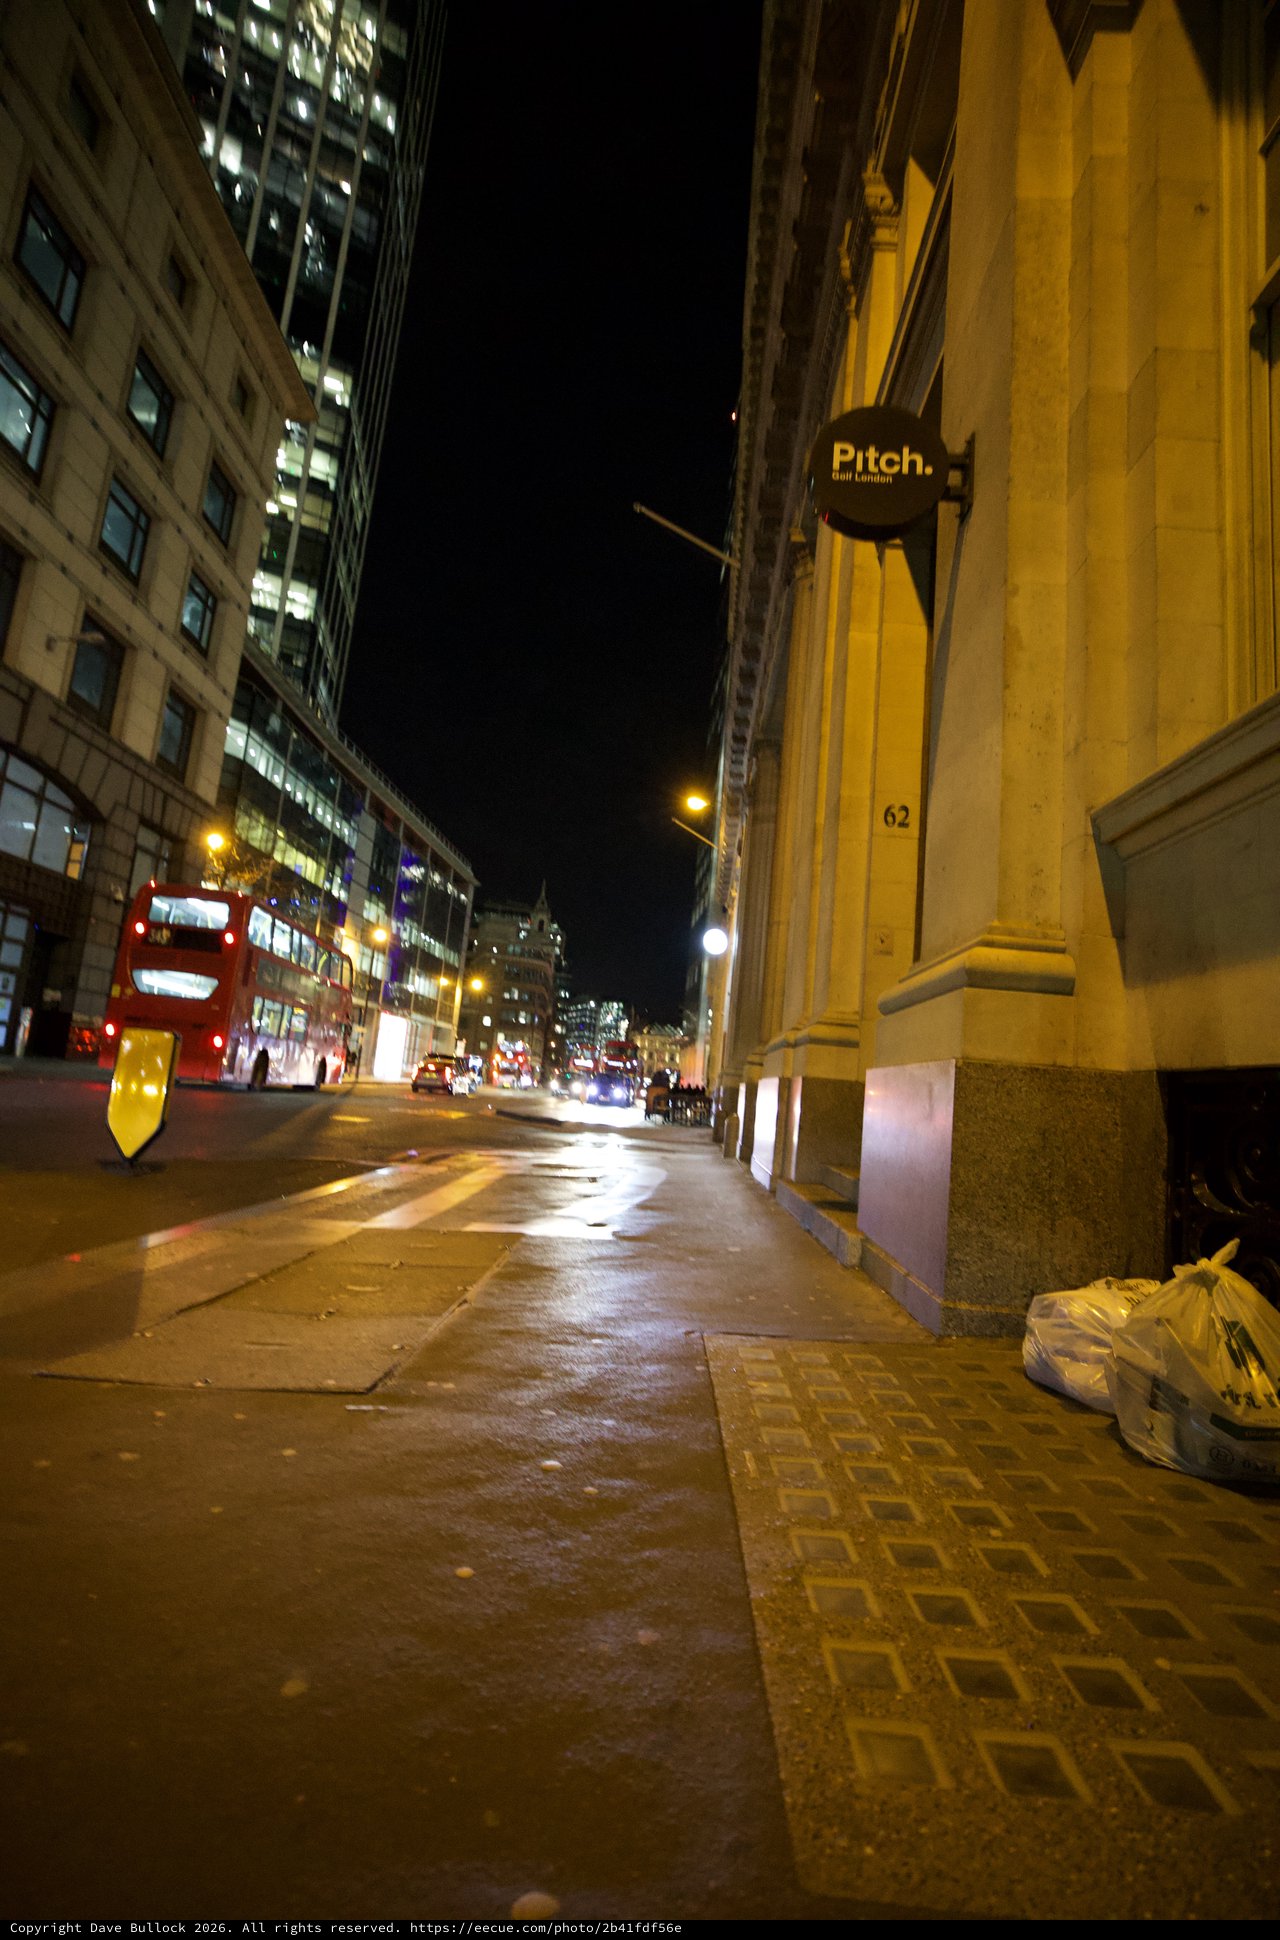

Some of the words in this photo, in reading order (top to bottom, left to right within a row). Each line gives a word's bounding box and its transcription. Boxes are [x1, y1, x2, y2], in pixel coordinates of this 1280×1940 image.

[832, 441, 933, 475] Pitch.
[832, 470, 853, 481] Golf
[855, 472, 893, 484] London
[884, 803, 910, 828] 62
